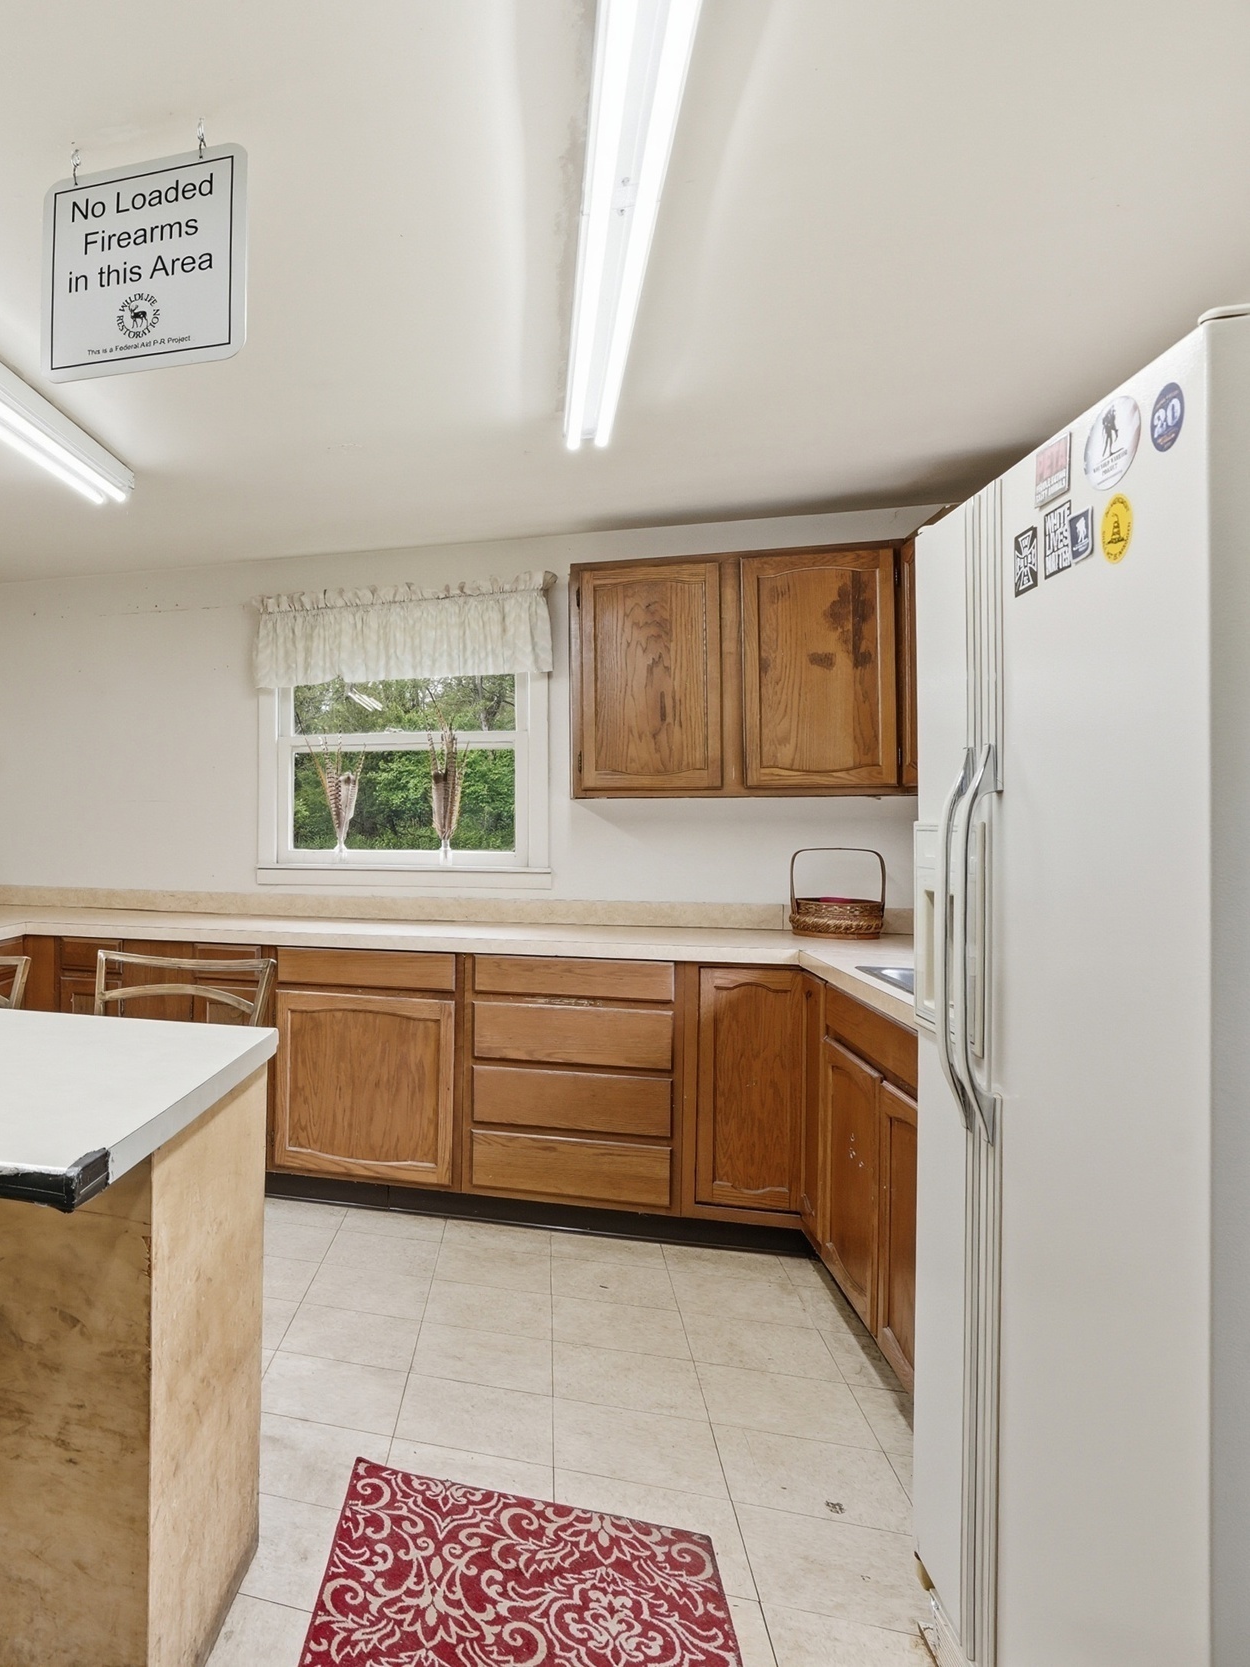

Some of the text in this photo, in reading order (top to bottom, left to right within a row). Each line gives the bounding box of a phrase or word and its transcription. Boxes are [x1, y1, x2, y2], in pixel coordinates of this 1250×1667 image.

[71, 172, 214, 223] No Loaded
[84, 217, 199, 255] Firearms
[68, 252, 213, 293] in this Area
[118, 292, 158, 313] WILDLIFE
[116, 308, 161, 339] RESTORATION
[115, 343, 139, 352] Federal
[139, 341, 152, 349] Aid
[167, 335, 191, 345] Project
[1045, 527, 1070, 557] LIVES
